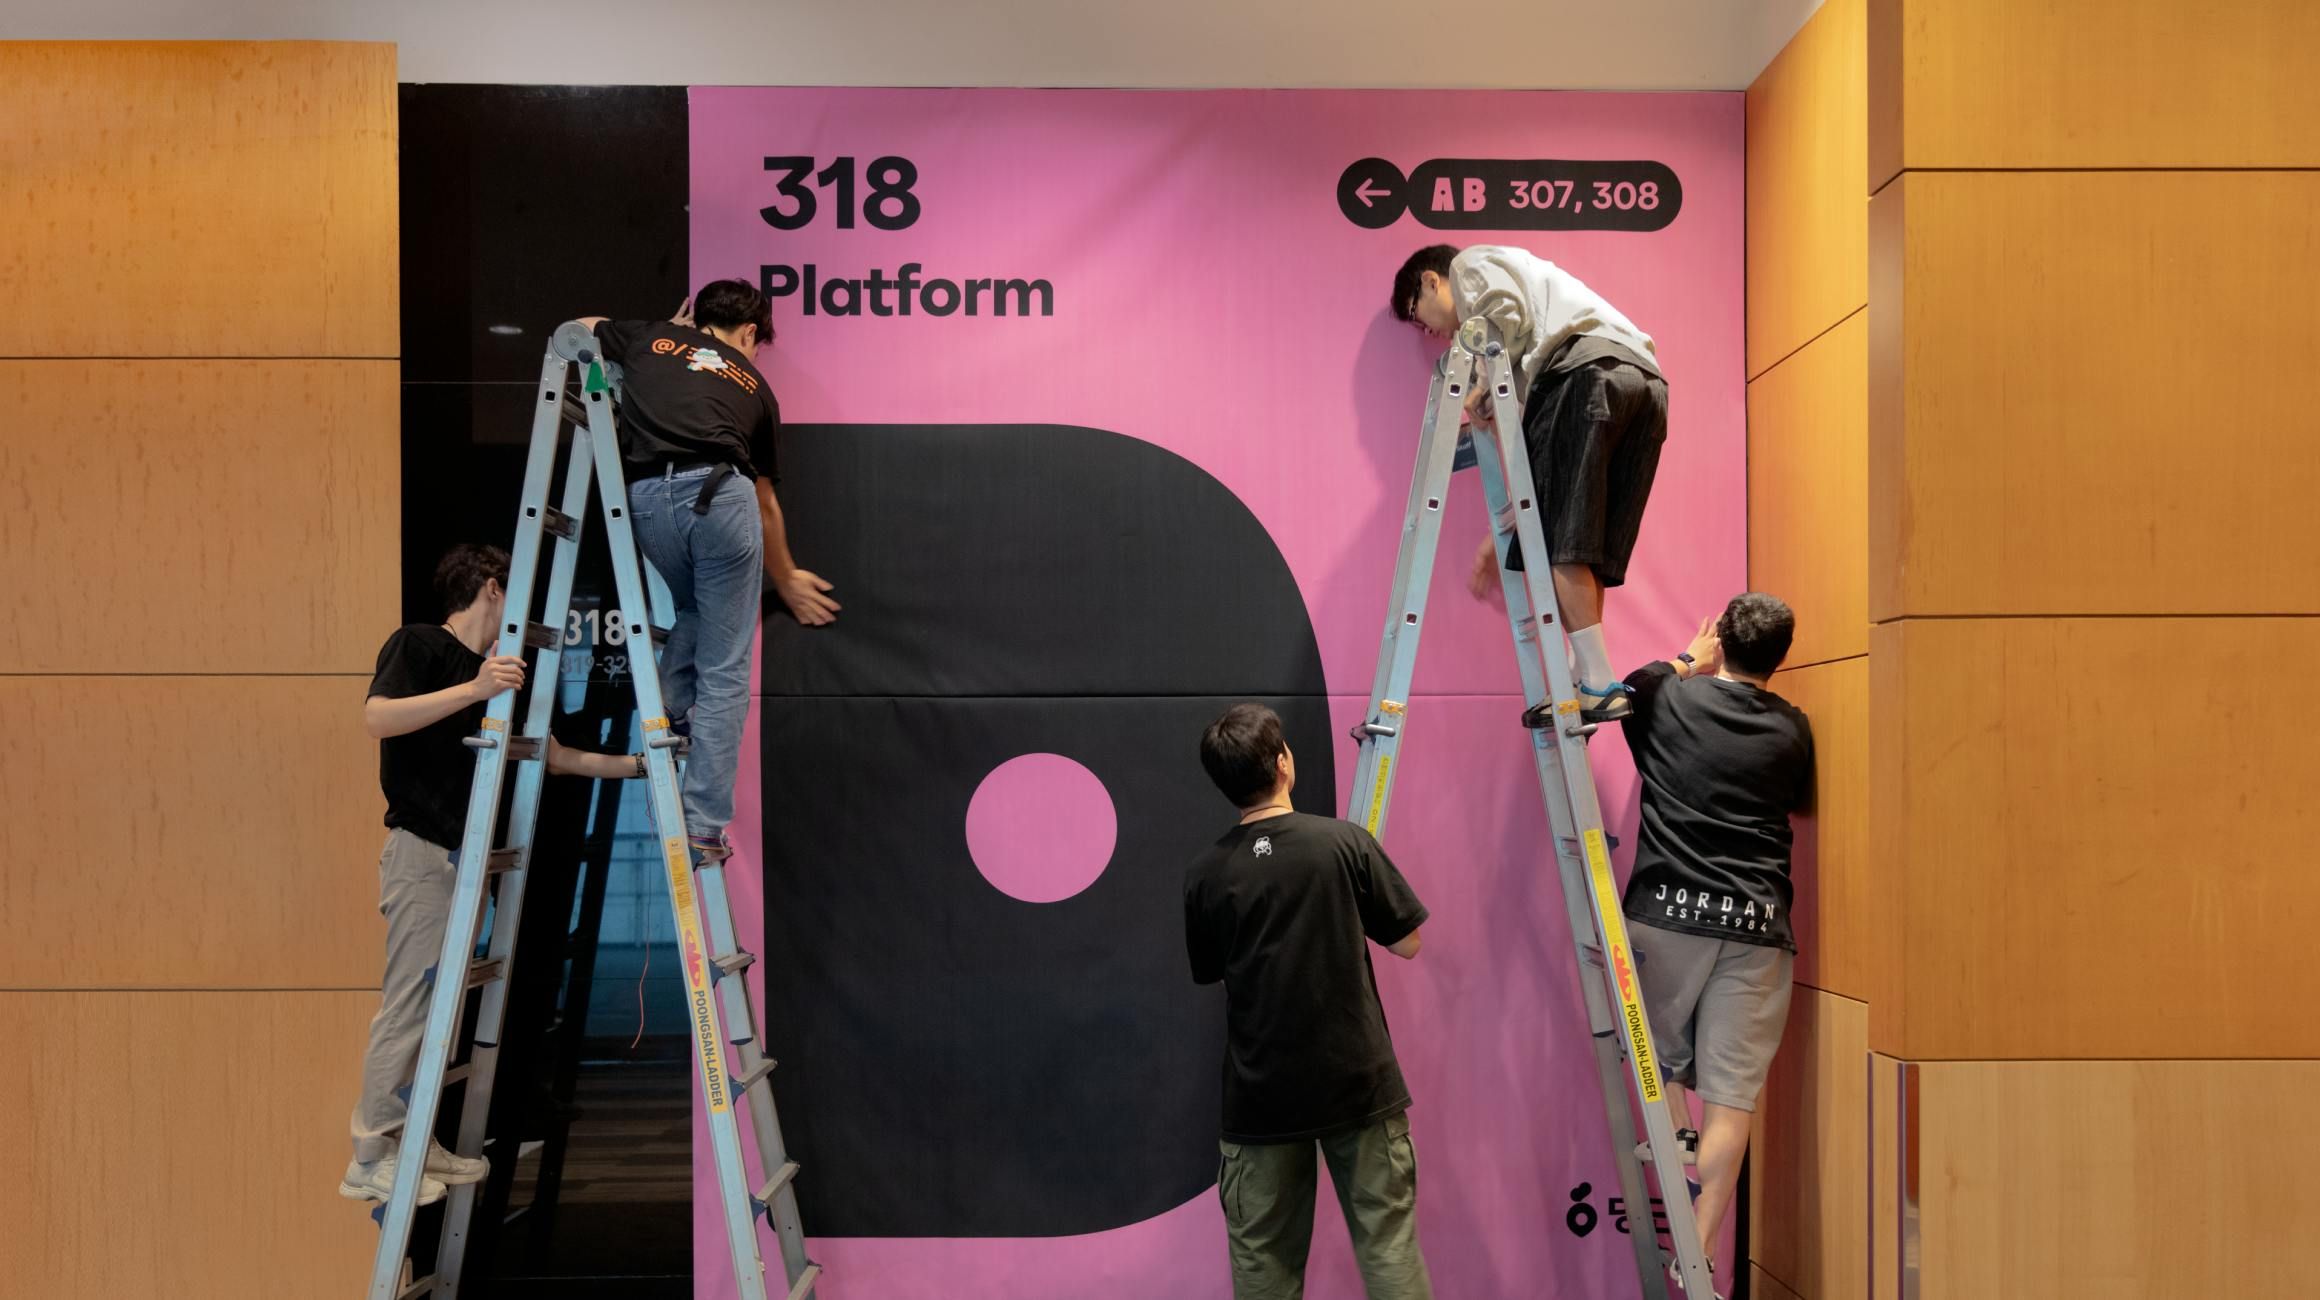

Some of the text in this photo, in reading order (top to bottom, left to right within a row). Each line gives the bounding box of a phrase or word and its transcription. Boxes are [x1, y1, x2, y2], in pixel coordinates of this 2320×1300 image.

[760, 156, 921, 231] 318
[1509, 181, 1583, 214] 307,
[1592, 181, 1660, 211] 308
[760, 263, 1053, 317] Platform
[565, 609, 626, 646] 318
[561, 656, 632, 674] 319-32
[1656, 884, 1775, 920] JORDAN
